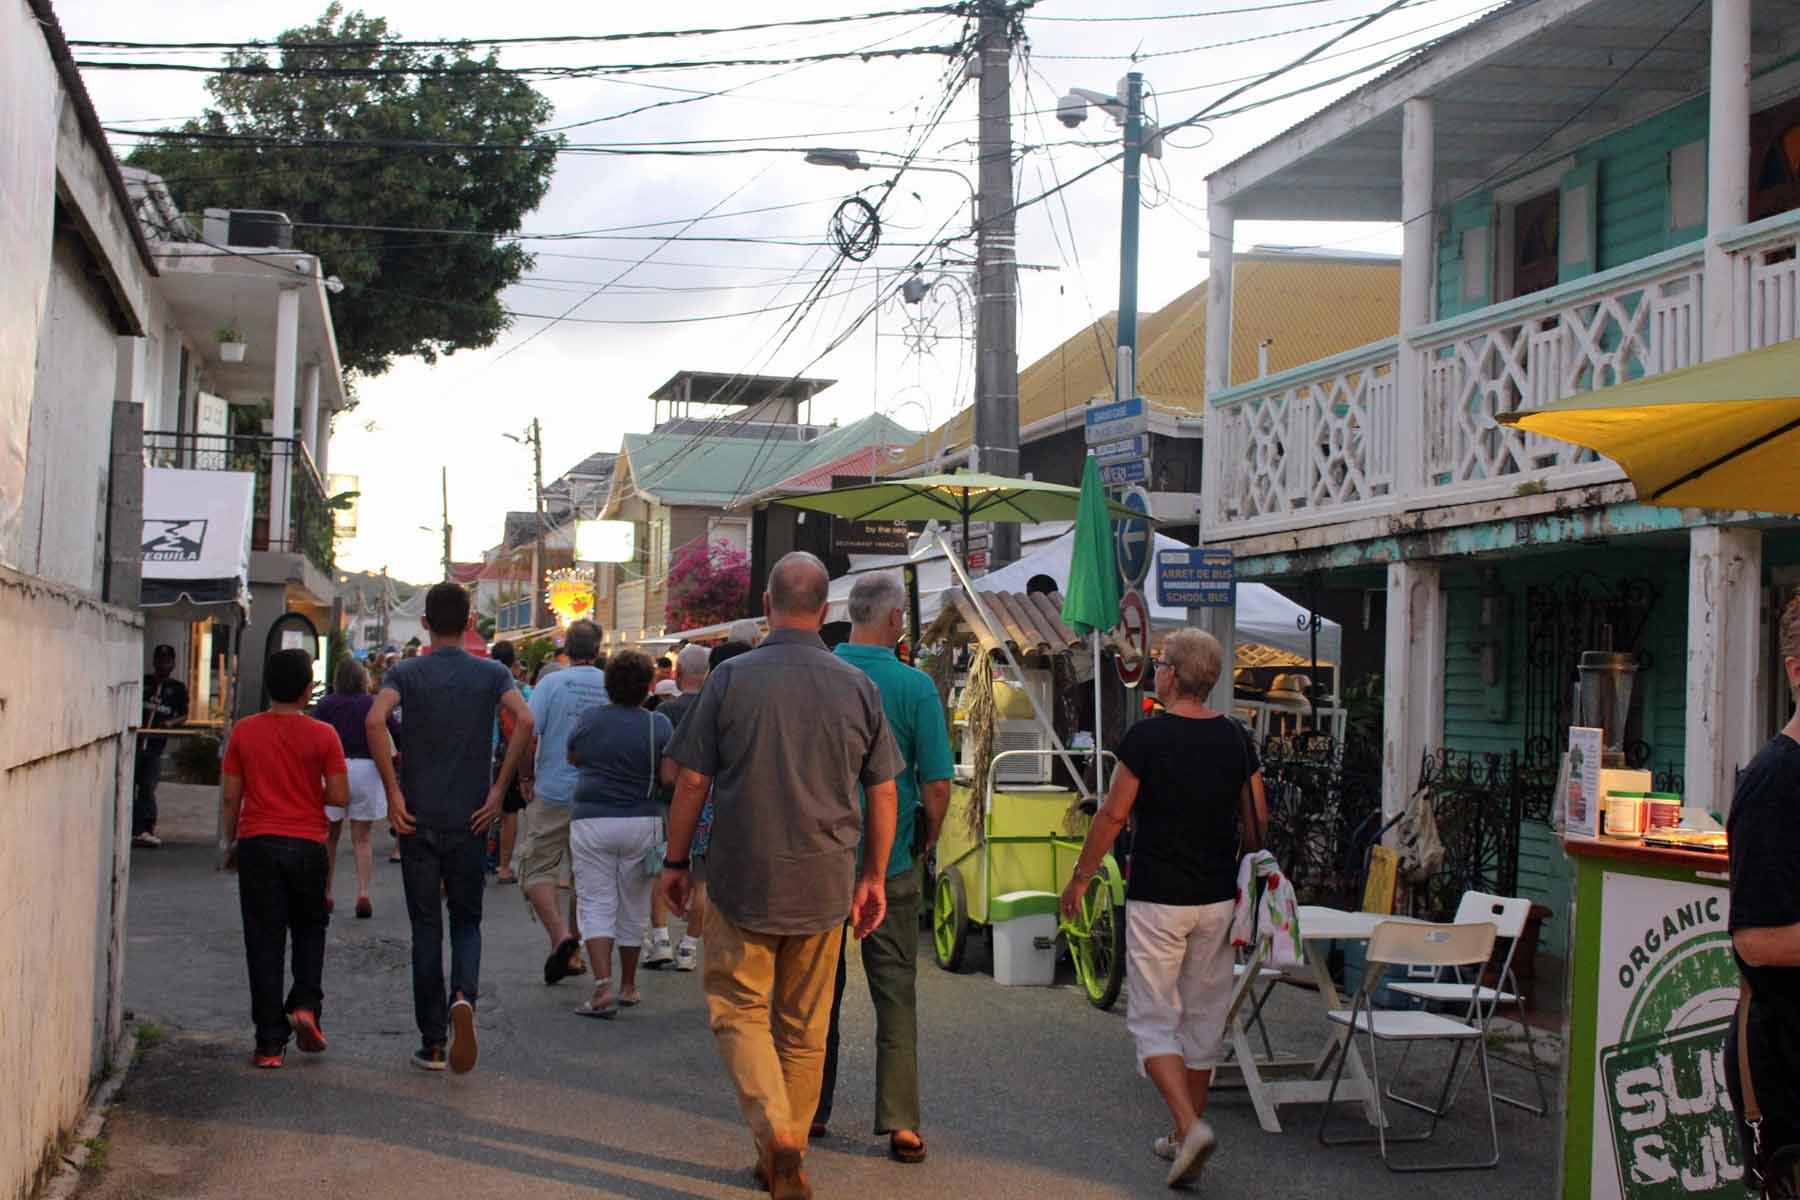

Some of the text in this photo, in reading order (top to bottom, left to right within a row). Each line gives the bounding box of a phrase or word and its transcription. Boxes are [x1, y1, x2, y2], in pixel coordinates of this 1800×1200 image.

[1212, 568, 1233, 578] BUS
[1167, 592, 1229, 602] SCHOOL BUS
[1618, 896, 1721, 989] ORGANIC
